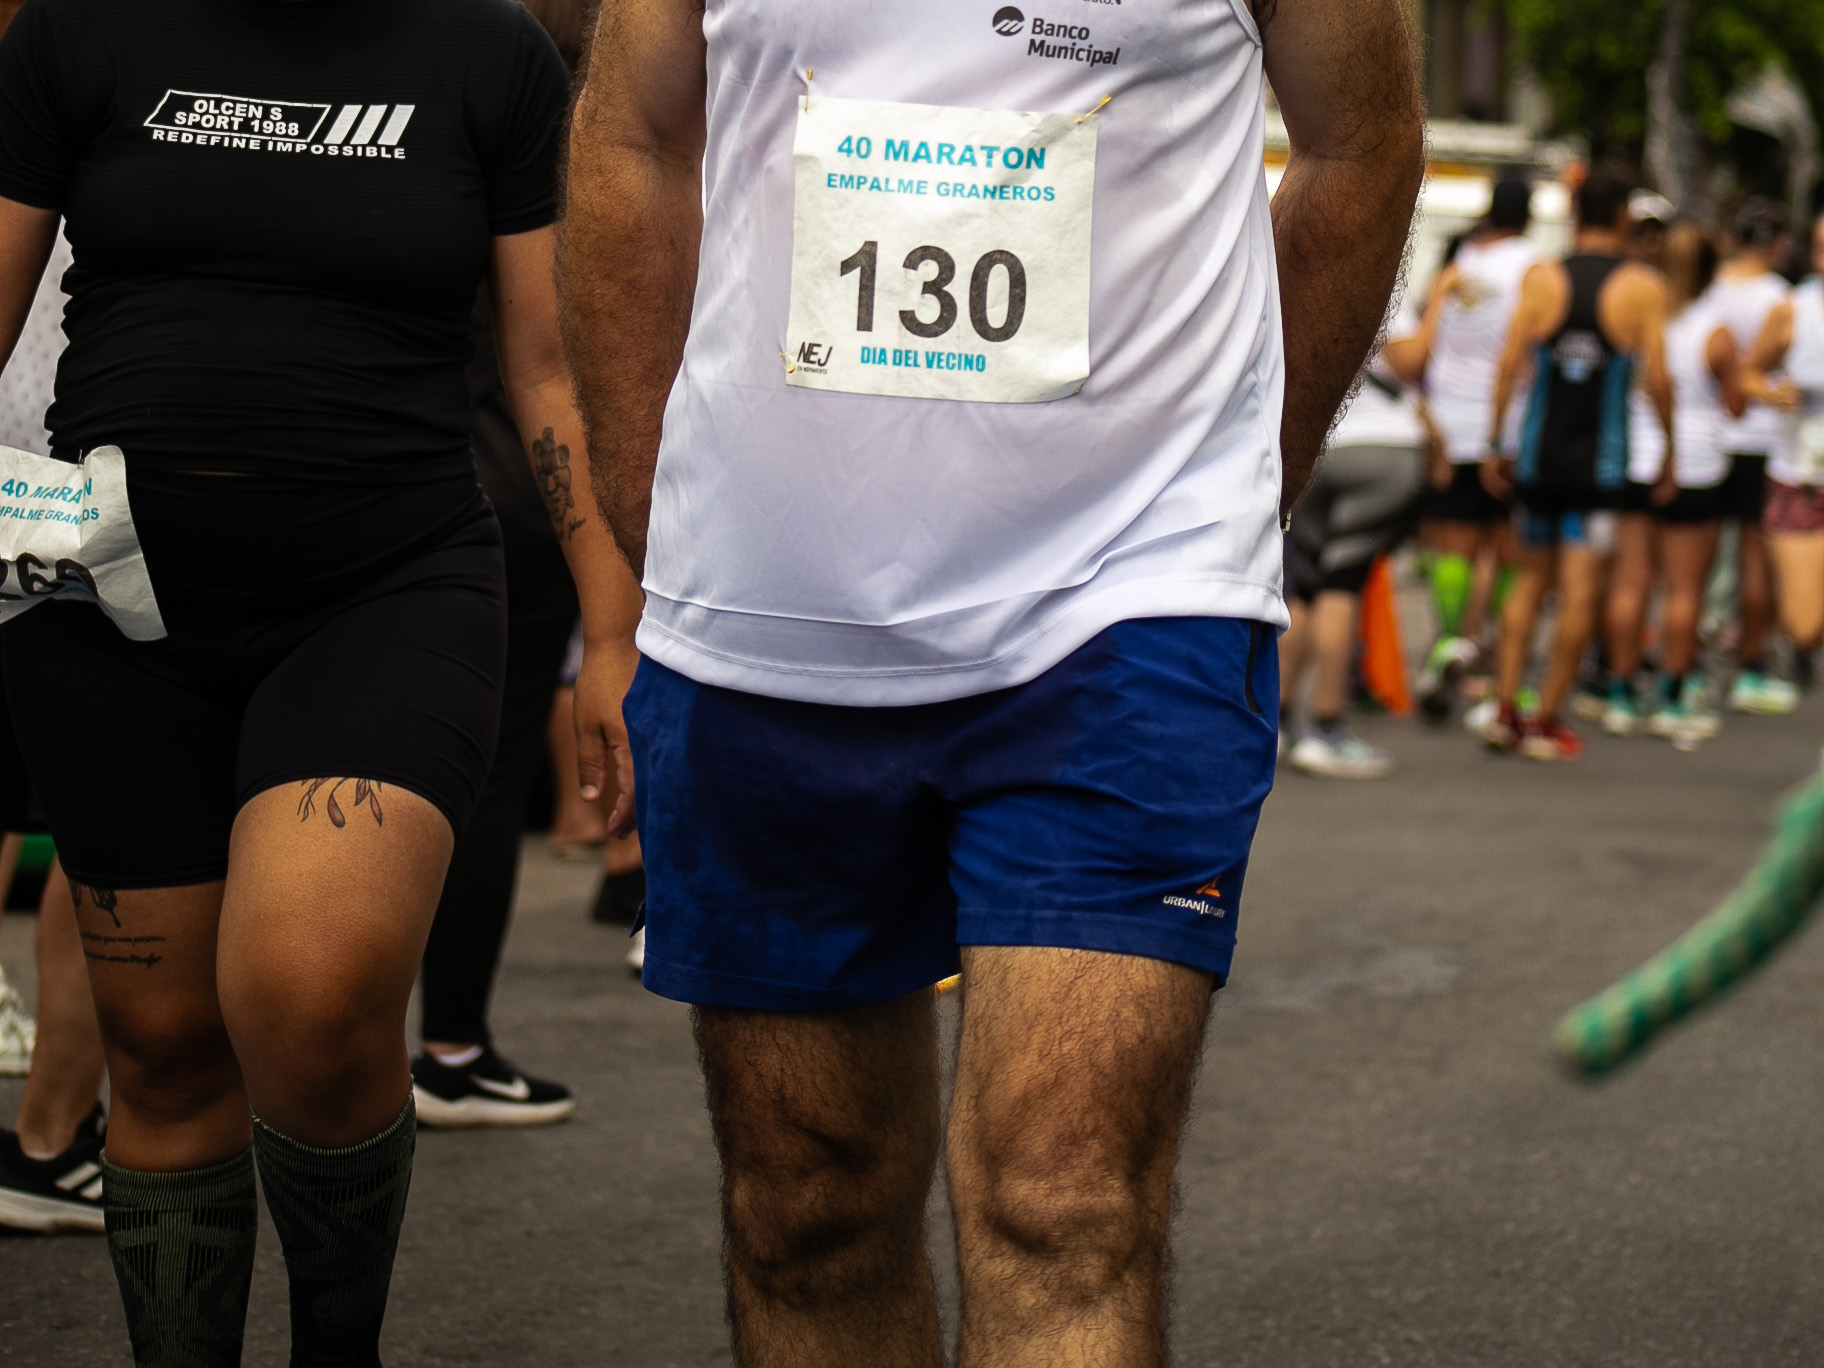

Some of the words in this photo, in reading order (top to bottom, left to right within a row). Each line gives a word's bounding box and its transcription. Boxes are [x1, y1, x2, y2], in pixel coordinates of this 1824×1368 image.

[1031, 17, 1089, 40] Banco
[1027, 38, 1120, 67] Municipal
[193, 99, 262, 118] OLCEN
[269, 107, 282, 120] S
[174, 111, 242, 130] SPORT
[250, 118, 298, 135] 1988
[152, 129, 260, 149] REDEFINE
[267, 140, 405, 158] IMPOSSIBLE
[837, 135, 872, 159] 40
[884, 139, 1046, 169] MARATON
[827, 173, 928, 194] EMPALME
[936, 182, 1055, 201] GRANEROS
[840, 240, 1026, 342] 130
[797, 341, 832, 367] NEJ
[860, 346, 888, 364] DIA
[892, 348, 919, 367] DEL
[925, 351, 985, 371] VECINO
[1, 478, 28, 498] 40
[1163, 895, 1200, 910] URBAN
